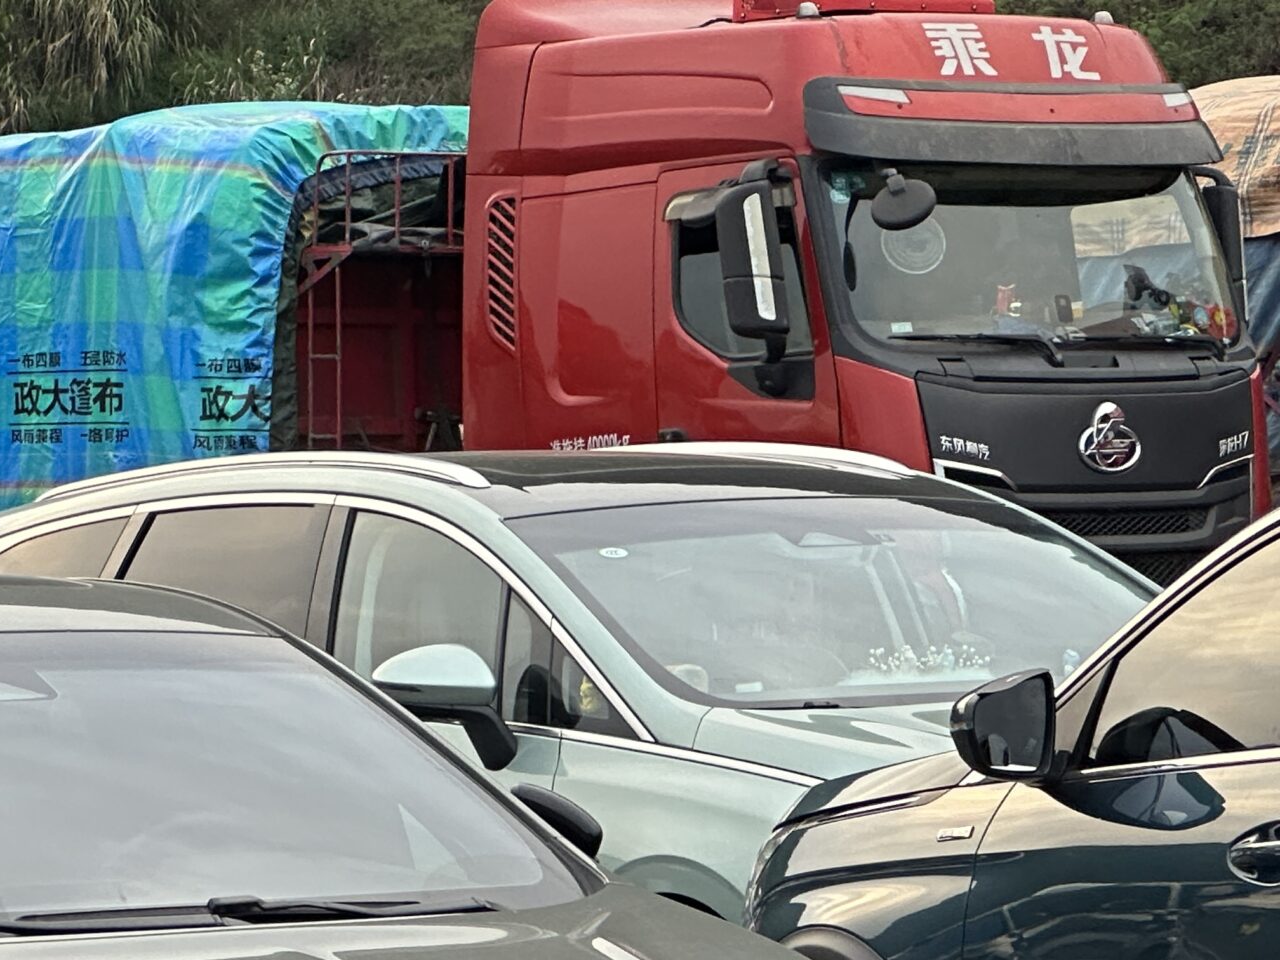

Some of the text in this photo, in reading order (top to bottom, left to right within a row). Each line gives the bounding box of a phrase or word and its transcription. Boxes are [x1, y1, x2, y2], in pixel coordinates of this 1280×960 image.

[921, 22, 1101, 80] 乘龙
[13, 377, 124, 417] 政大篷布
